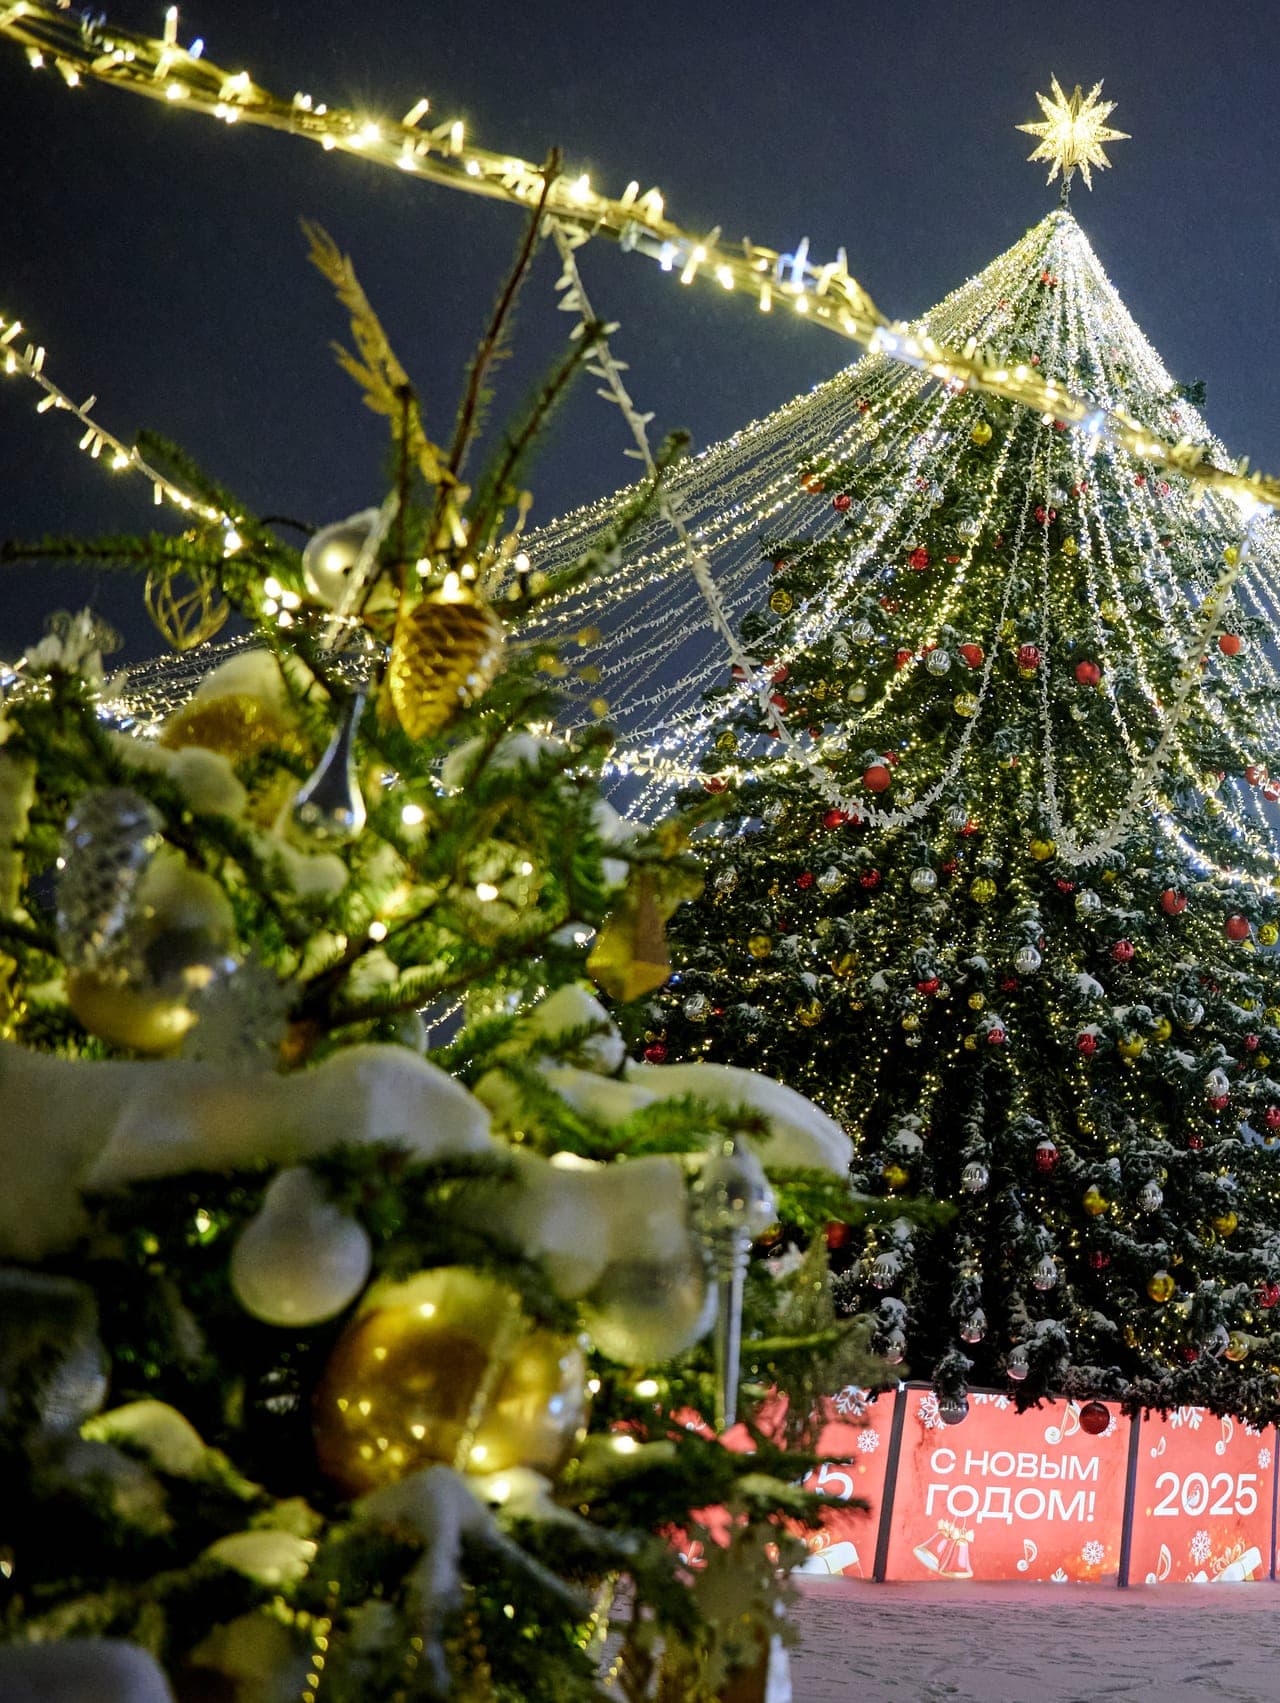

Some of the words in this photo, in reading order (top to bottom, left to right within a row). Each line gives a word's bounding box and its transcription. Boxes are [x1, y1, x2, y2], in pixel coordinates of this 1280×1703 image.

[930, 1447, 957, 1475] С
[963, 1449, 1100, 1482] НОВЫМ
[925, 1483, 1097, 1526] ГОДОМ!
[1153, 1471, 1258, 1517] 2025
